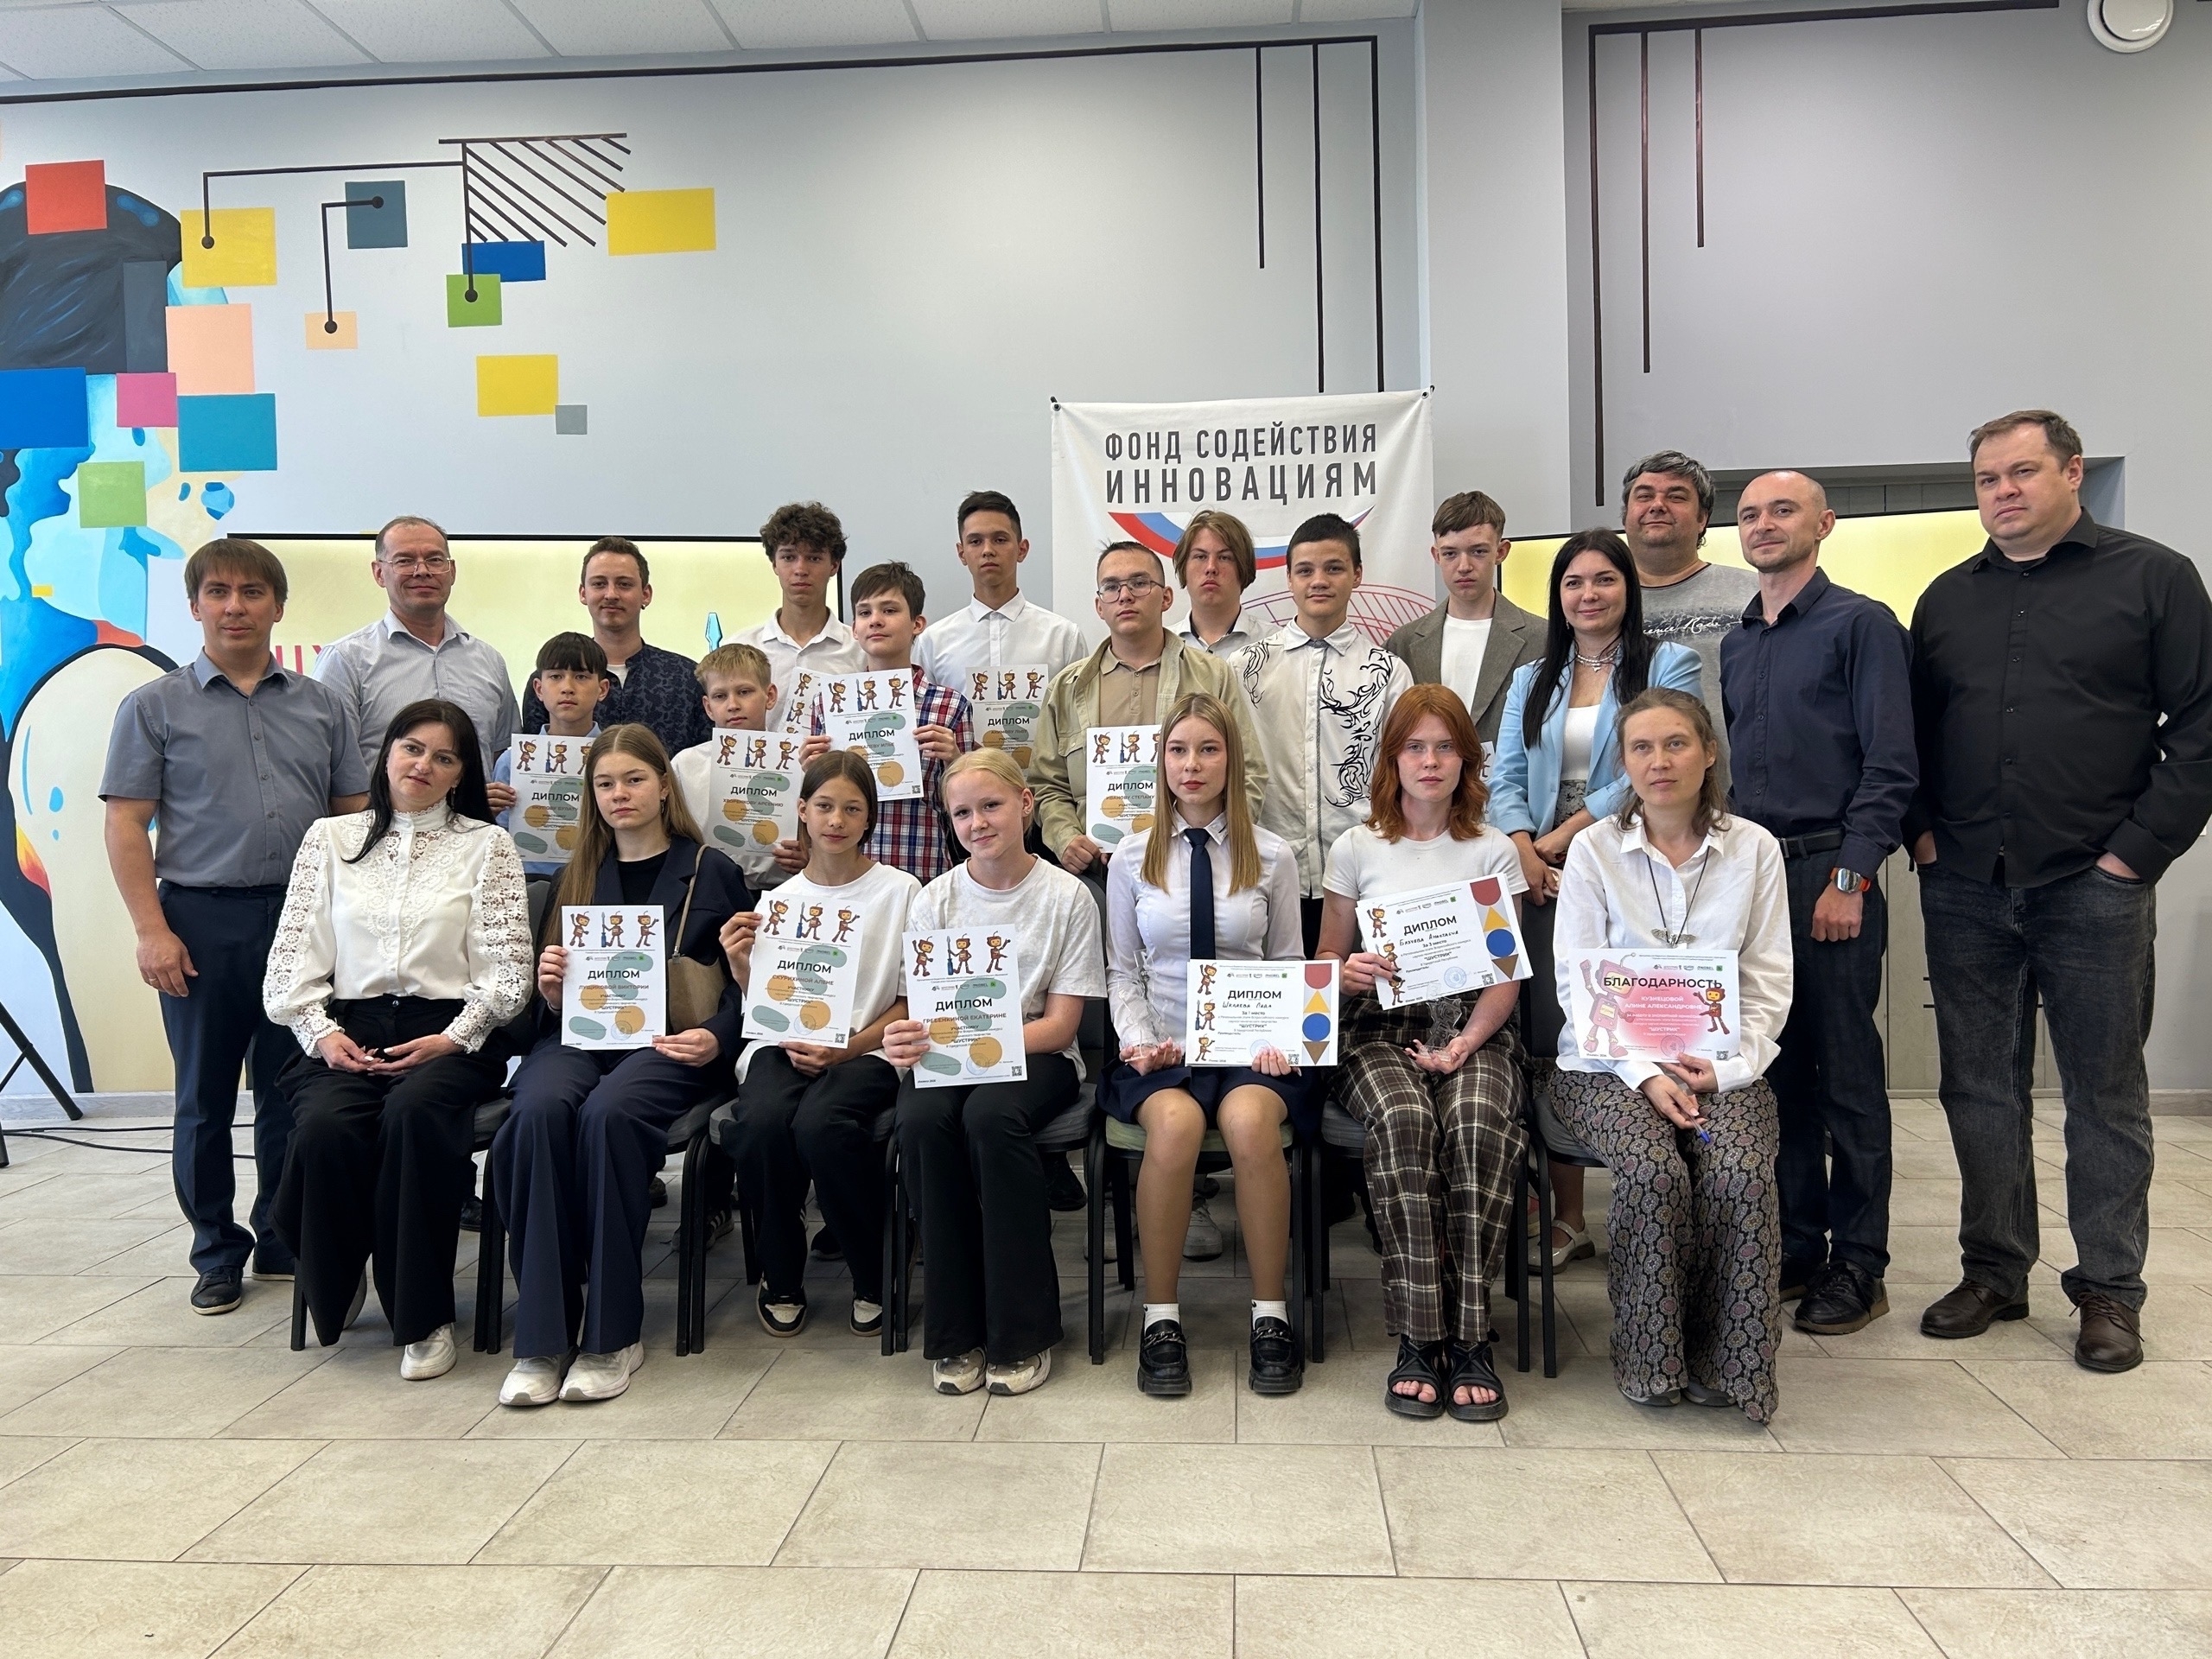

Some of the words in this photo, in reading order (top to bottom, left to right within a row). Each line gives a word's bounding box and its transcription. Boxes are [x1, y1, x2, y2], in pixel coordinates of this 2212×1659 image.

[1105, 432, 1181, 464] ФОНД
[1197, 422, 1376, 462] СОДЕЙСТВИЯ
[1106, 461, 1376, 505] ИННОВАЦИЯМ
[988, 718, 1030, 726] ДИПЛОМ
[849, 729, 895, 741] ДИПЛОМ
[731, 787, 777, 797] ДИПЛОМ
[1108, 782, 1153, 791] ДИПЛОМ
[531, 792, 579, 802] ДИПЛОМ
[1403, 915, 1457, 936] ДИПЛОМ
[777, 960, 831, 973] ДИПЛОМ
[588, 970, 640, 980] ДИПЛОМ
[1604, 977, 1722, 989] БЛАГОДАРНОСТЬ
[1228, 990, 1281, 1000] ДИПЛОМ
[935, 998, 992, 1012] ДИПЛОМ
